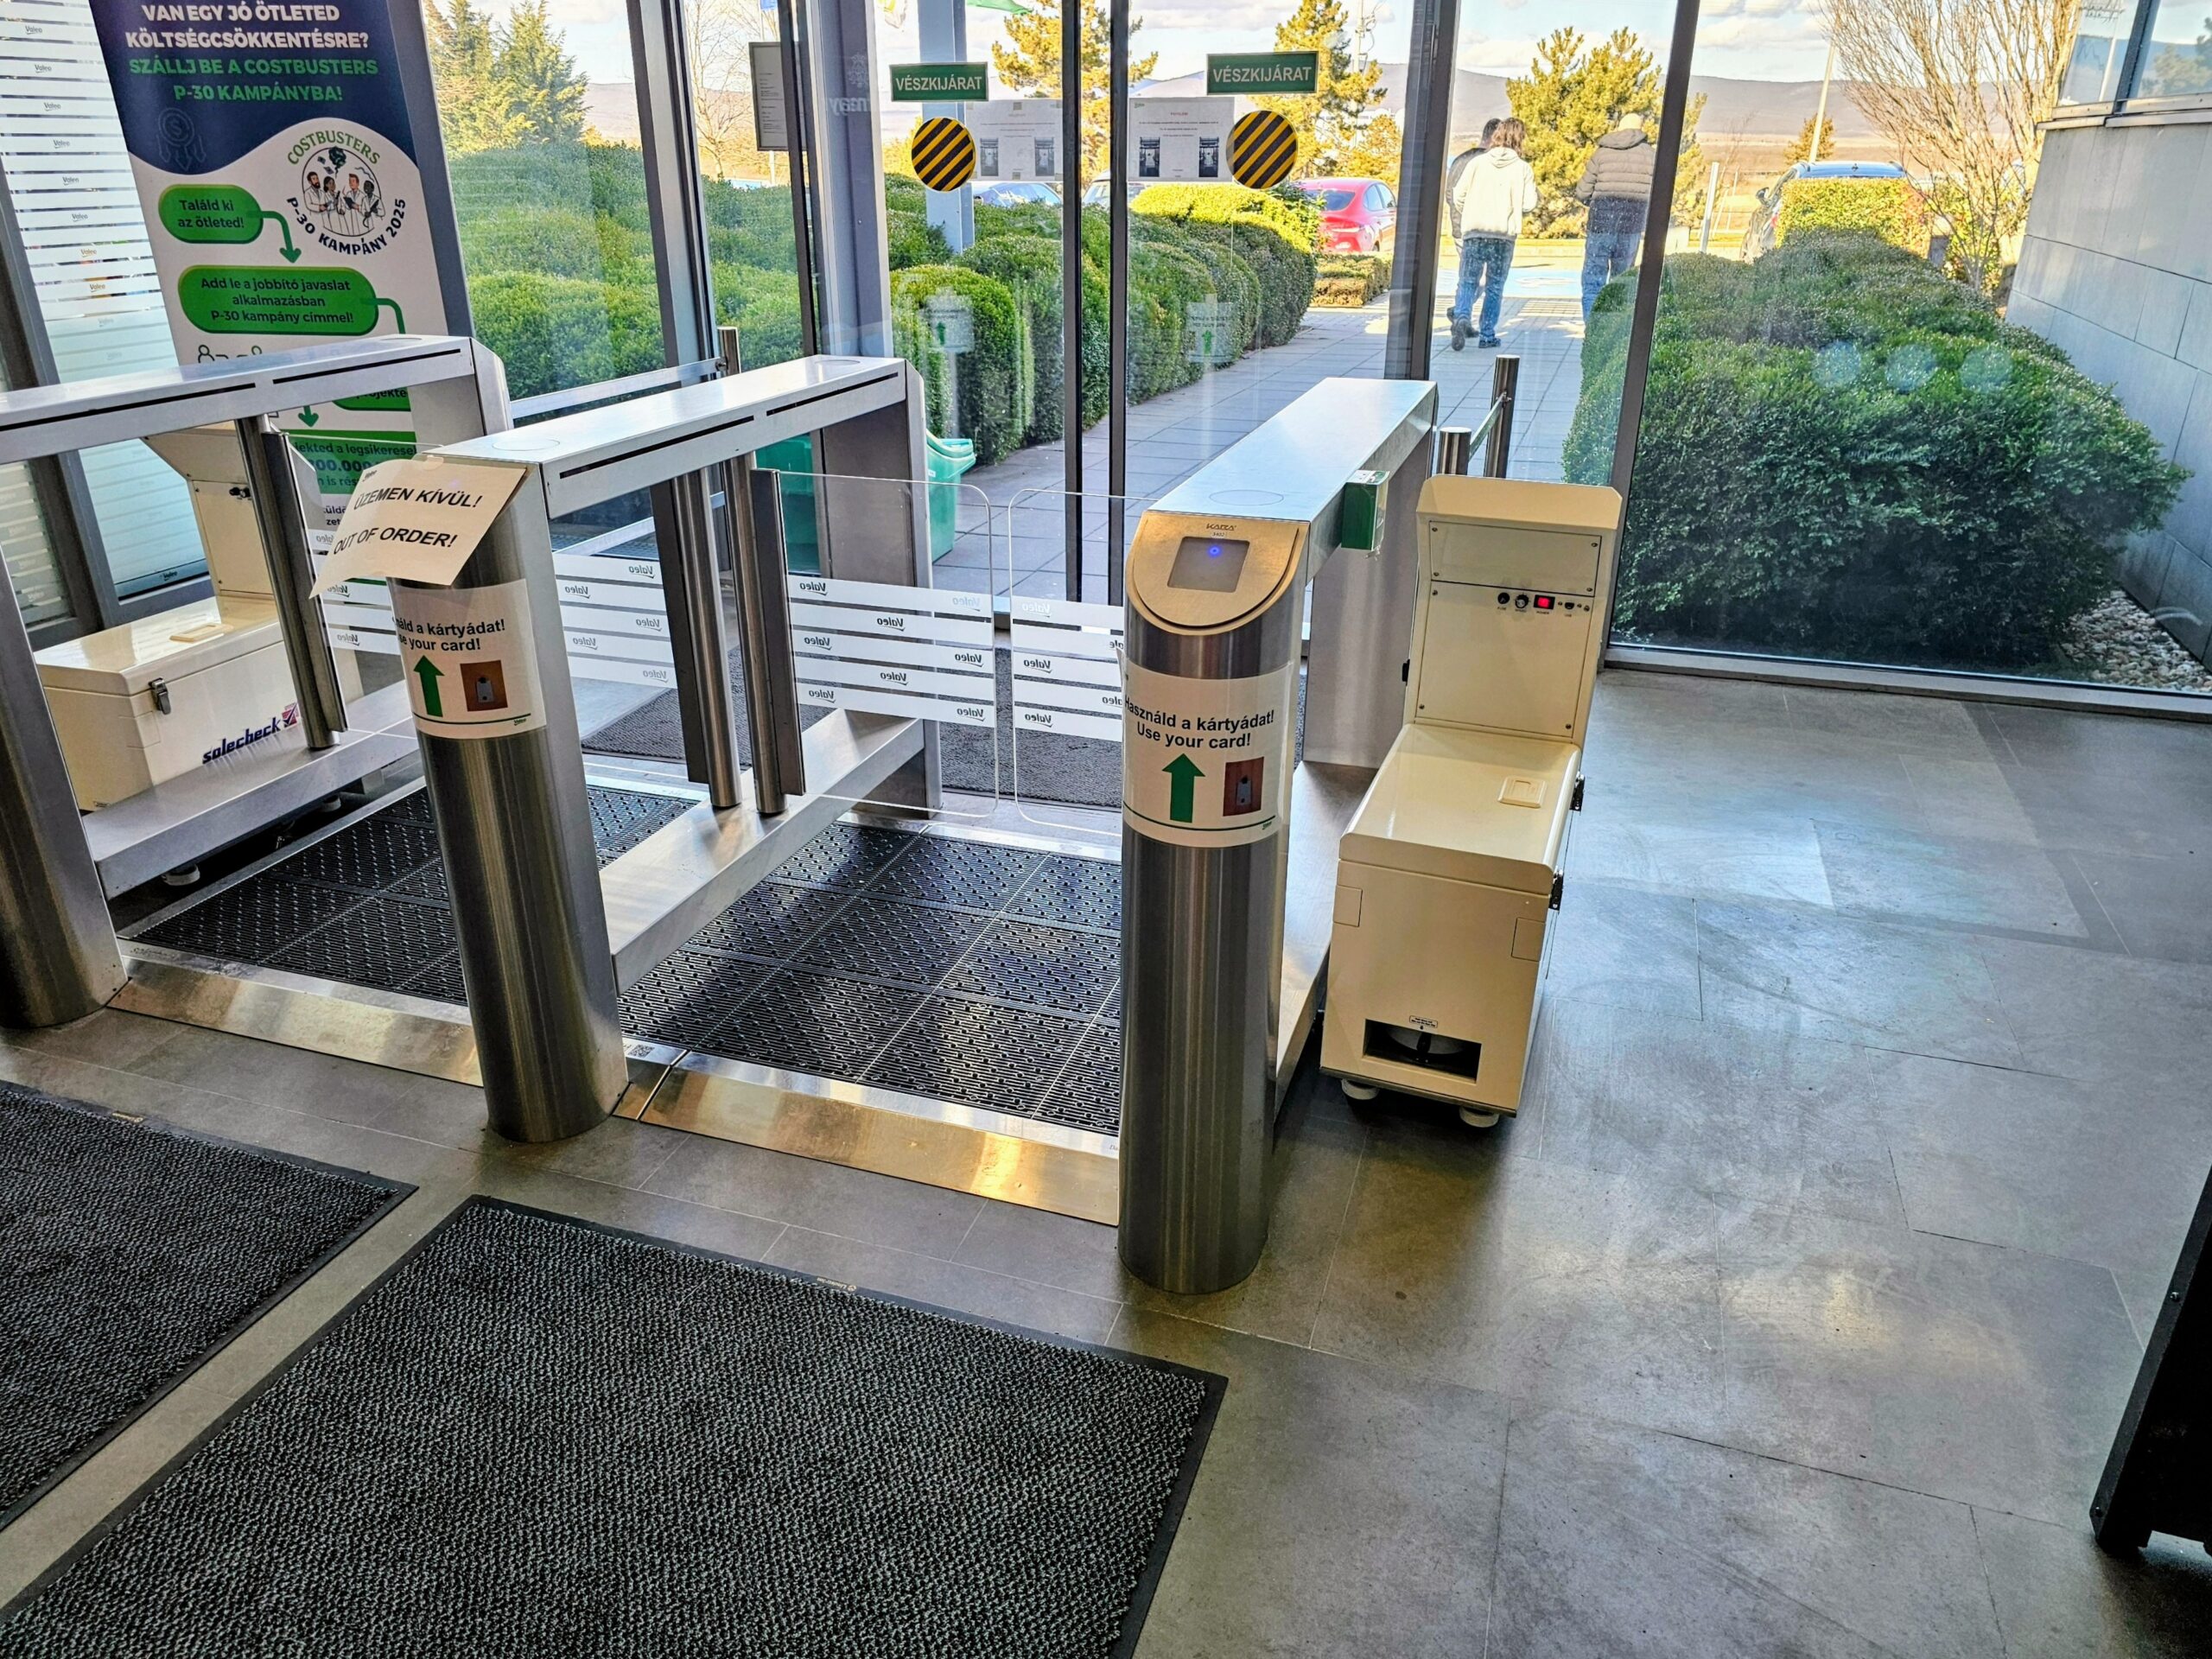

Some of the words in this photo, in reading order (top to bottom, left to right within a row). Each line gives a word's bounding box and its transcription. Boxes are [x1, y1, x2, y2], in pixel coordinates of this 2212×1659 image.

[141, 4, 185, 21] VAN
[188, 4, 224, 21] EGY
[228, 0, 251, 21] JÓ
[256, 0, 340, 21] ÖTLETED
[125, 28, 369, 48] KÖLTSÉGCSÖKKENTÉSRE?
[130, 54, 196, 74] SZÁLLJ
[200, 60, 224, 74] BE
[228, 60, 242, 74] A
[245, 60, 378, 74] COSTBUSTERS
[1213, 65, 1312, 82] VÉSZKIJÁRAT
[174, 86, 214, 100] P-30
[218, 81, 343, 101] KAMPÁNYBA!
[896, 74, 982, 91] VÉSZKIJÁRAT
[287, 130, 380, 165] COSTBUSTERS
[179, 199, 219, 211] Találd
[223, 199, 233, 211] ki
[178, 219, 193, 228] az
[195, 216, 244, 229] ötleted!
[287, 197, 315, 234] P-30
[319, 232, 388, 255] KAMPÁNY
[386, 198, 406, 238] 2025
[201, 278, 226, 289] Add
[230, 278, 240, 289] le
[252, 278, 299, 291] jobbító
[301, 279, 351, 292] javaslat
[232, 294, 326, 307] alkalmazásban
[211, 310, 239, 321] P-30
[243, 310, 300, 325] kampány
[303, 311, 354, 323] címmel!
[346, 443, 416, 456] legsikerese
[327, 476, 337, 486] is
[340, 476, 359, 486] rés
[353, 487, 415, 511] ÜZEMEN
[416, 488, 483, 508] KÍVÜL!
[334, 532, 358, 555] OUT
[357, 527, 379, 543] OF
[379, 527, 458, 549] ORDER!
[416, 624, 423, 634] a
[427, 619, 505, 638] kártyádat!
[409, 637, 436, 650] your
[441, 638, 480, 651] card!
[1125, 695, 1176, 728] Használd
[1181, 719, 1191, 729] a
[1197, 709, 1274, 734] kártyádat!
[202, 716, 281, 765] solecheck
[1137, 721, 1160, 741] Use
[1165, 734, 1204, 748] your
[1209, 733, 1250, 748] card!
